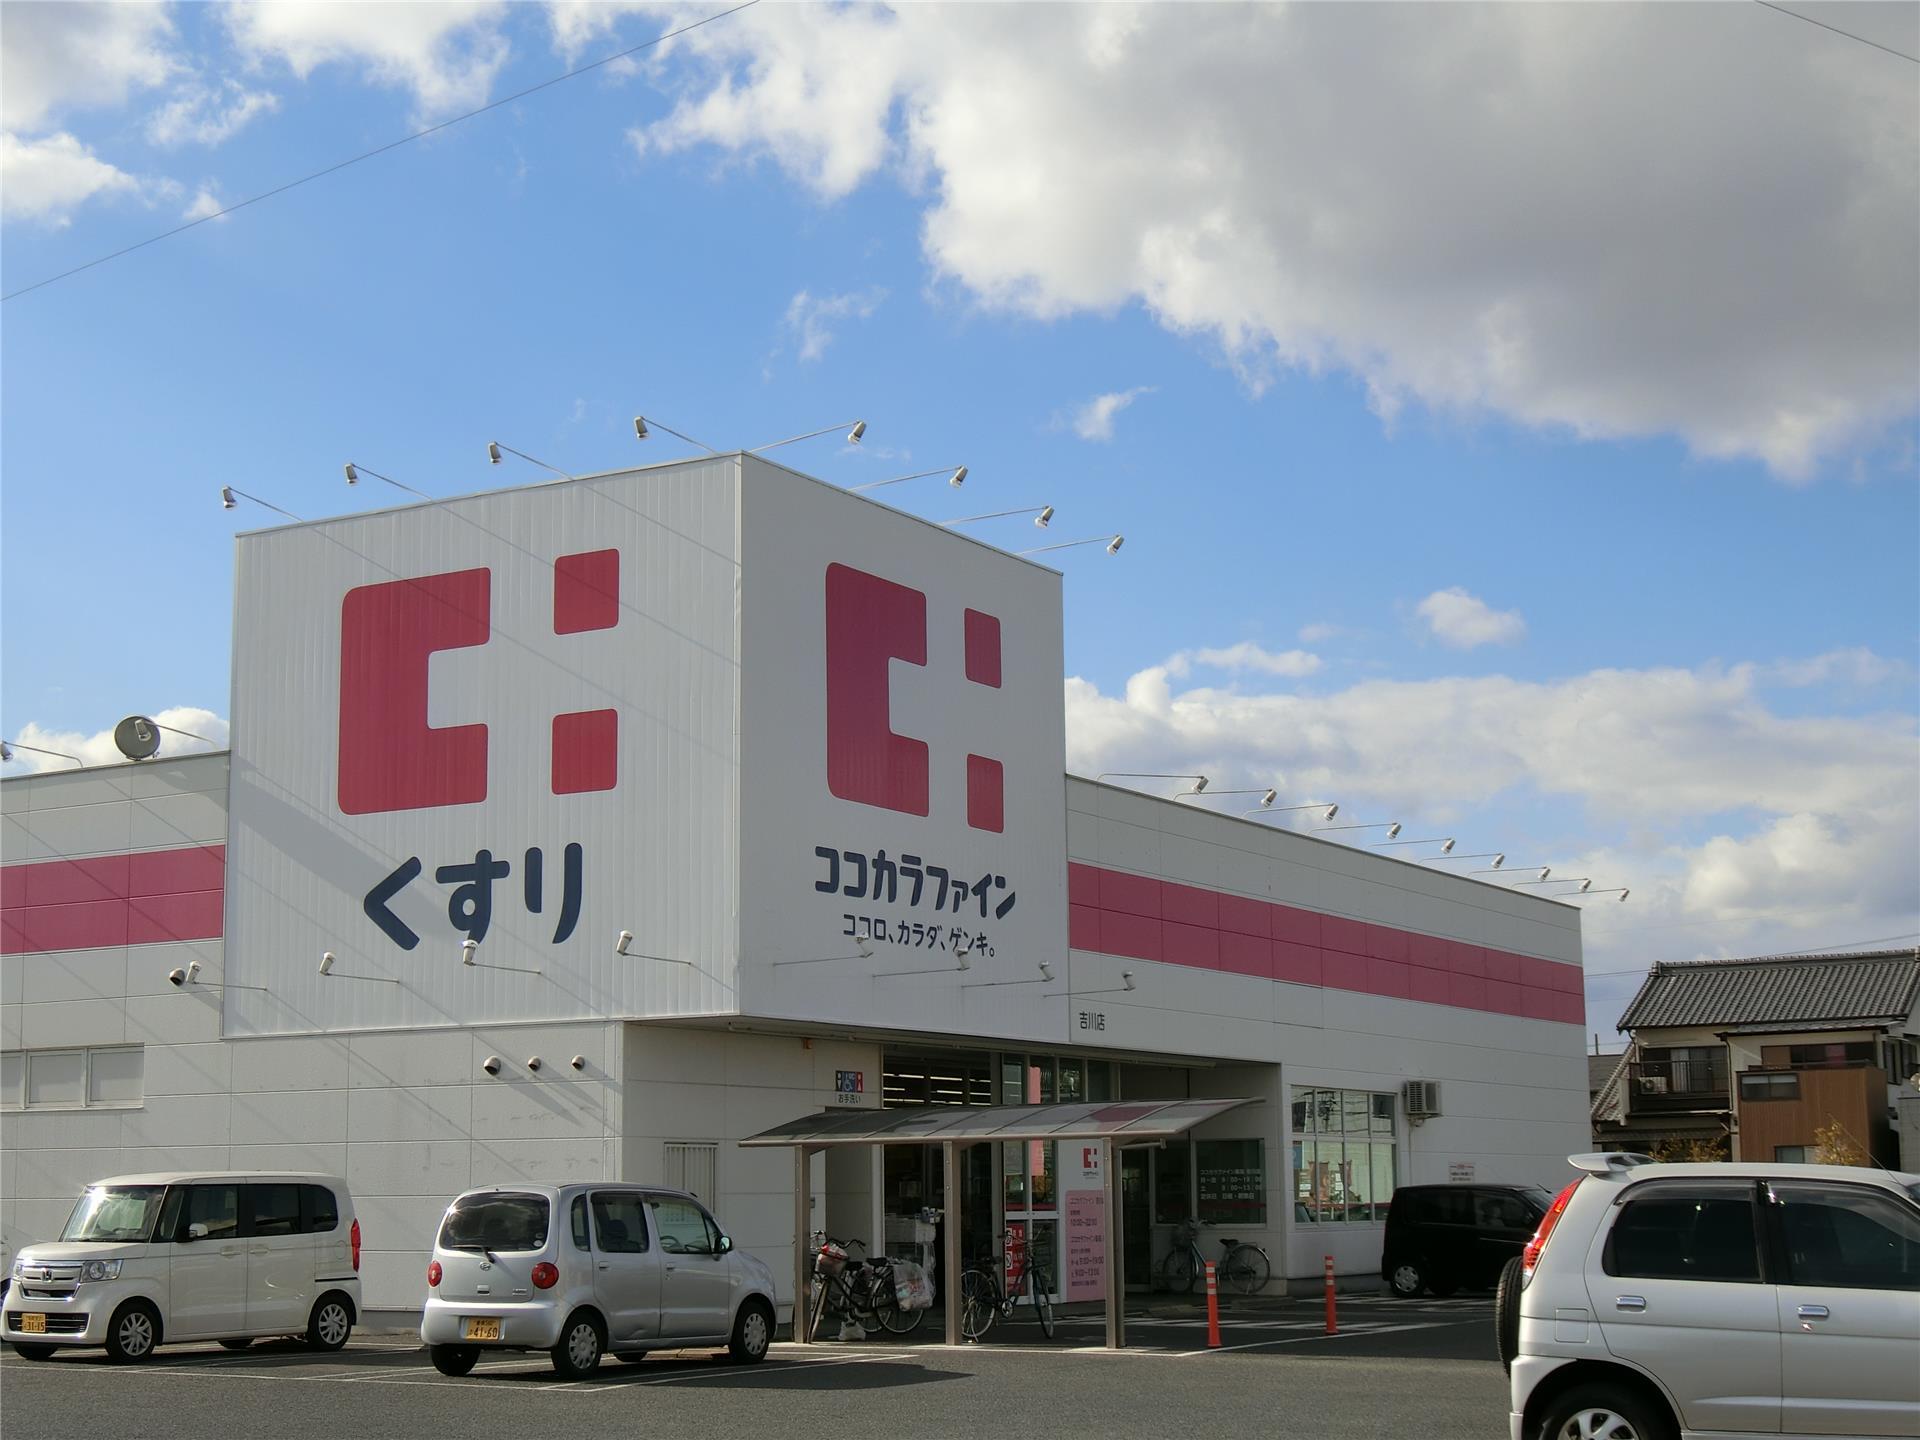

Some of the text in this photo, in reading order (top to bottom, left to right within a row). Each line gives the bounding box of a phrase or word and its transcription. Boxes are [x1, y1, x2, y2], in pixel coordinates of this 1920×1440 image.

[363, 843, 583, 951] くすり
[815, 846, 1016, 920] ココカラファイン
[843, 913, 995, 958] ココロ、カラダ、ゲンキ。
[1079, 1011, 1105, 1031] 吉川店
